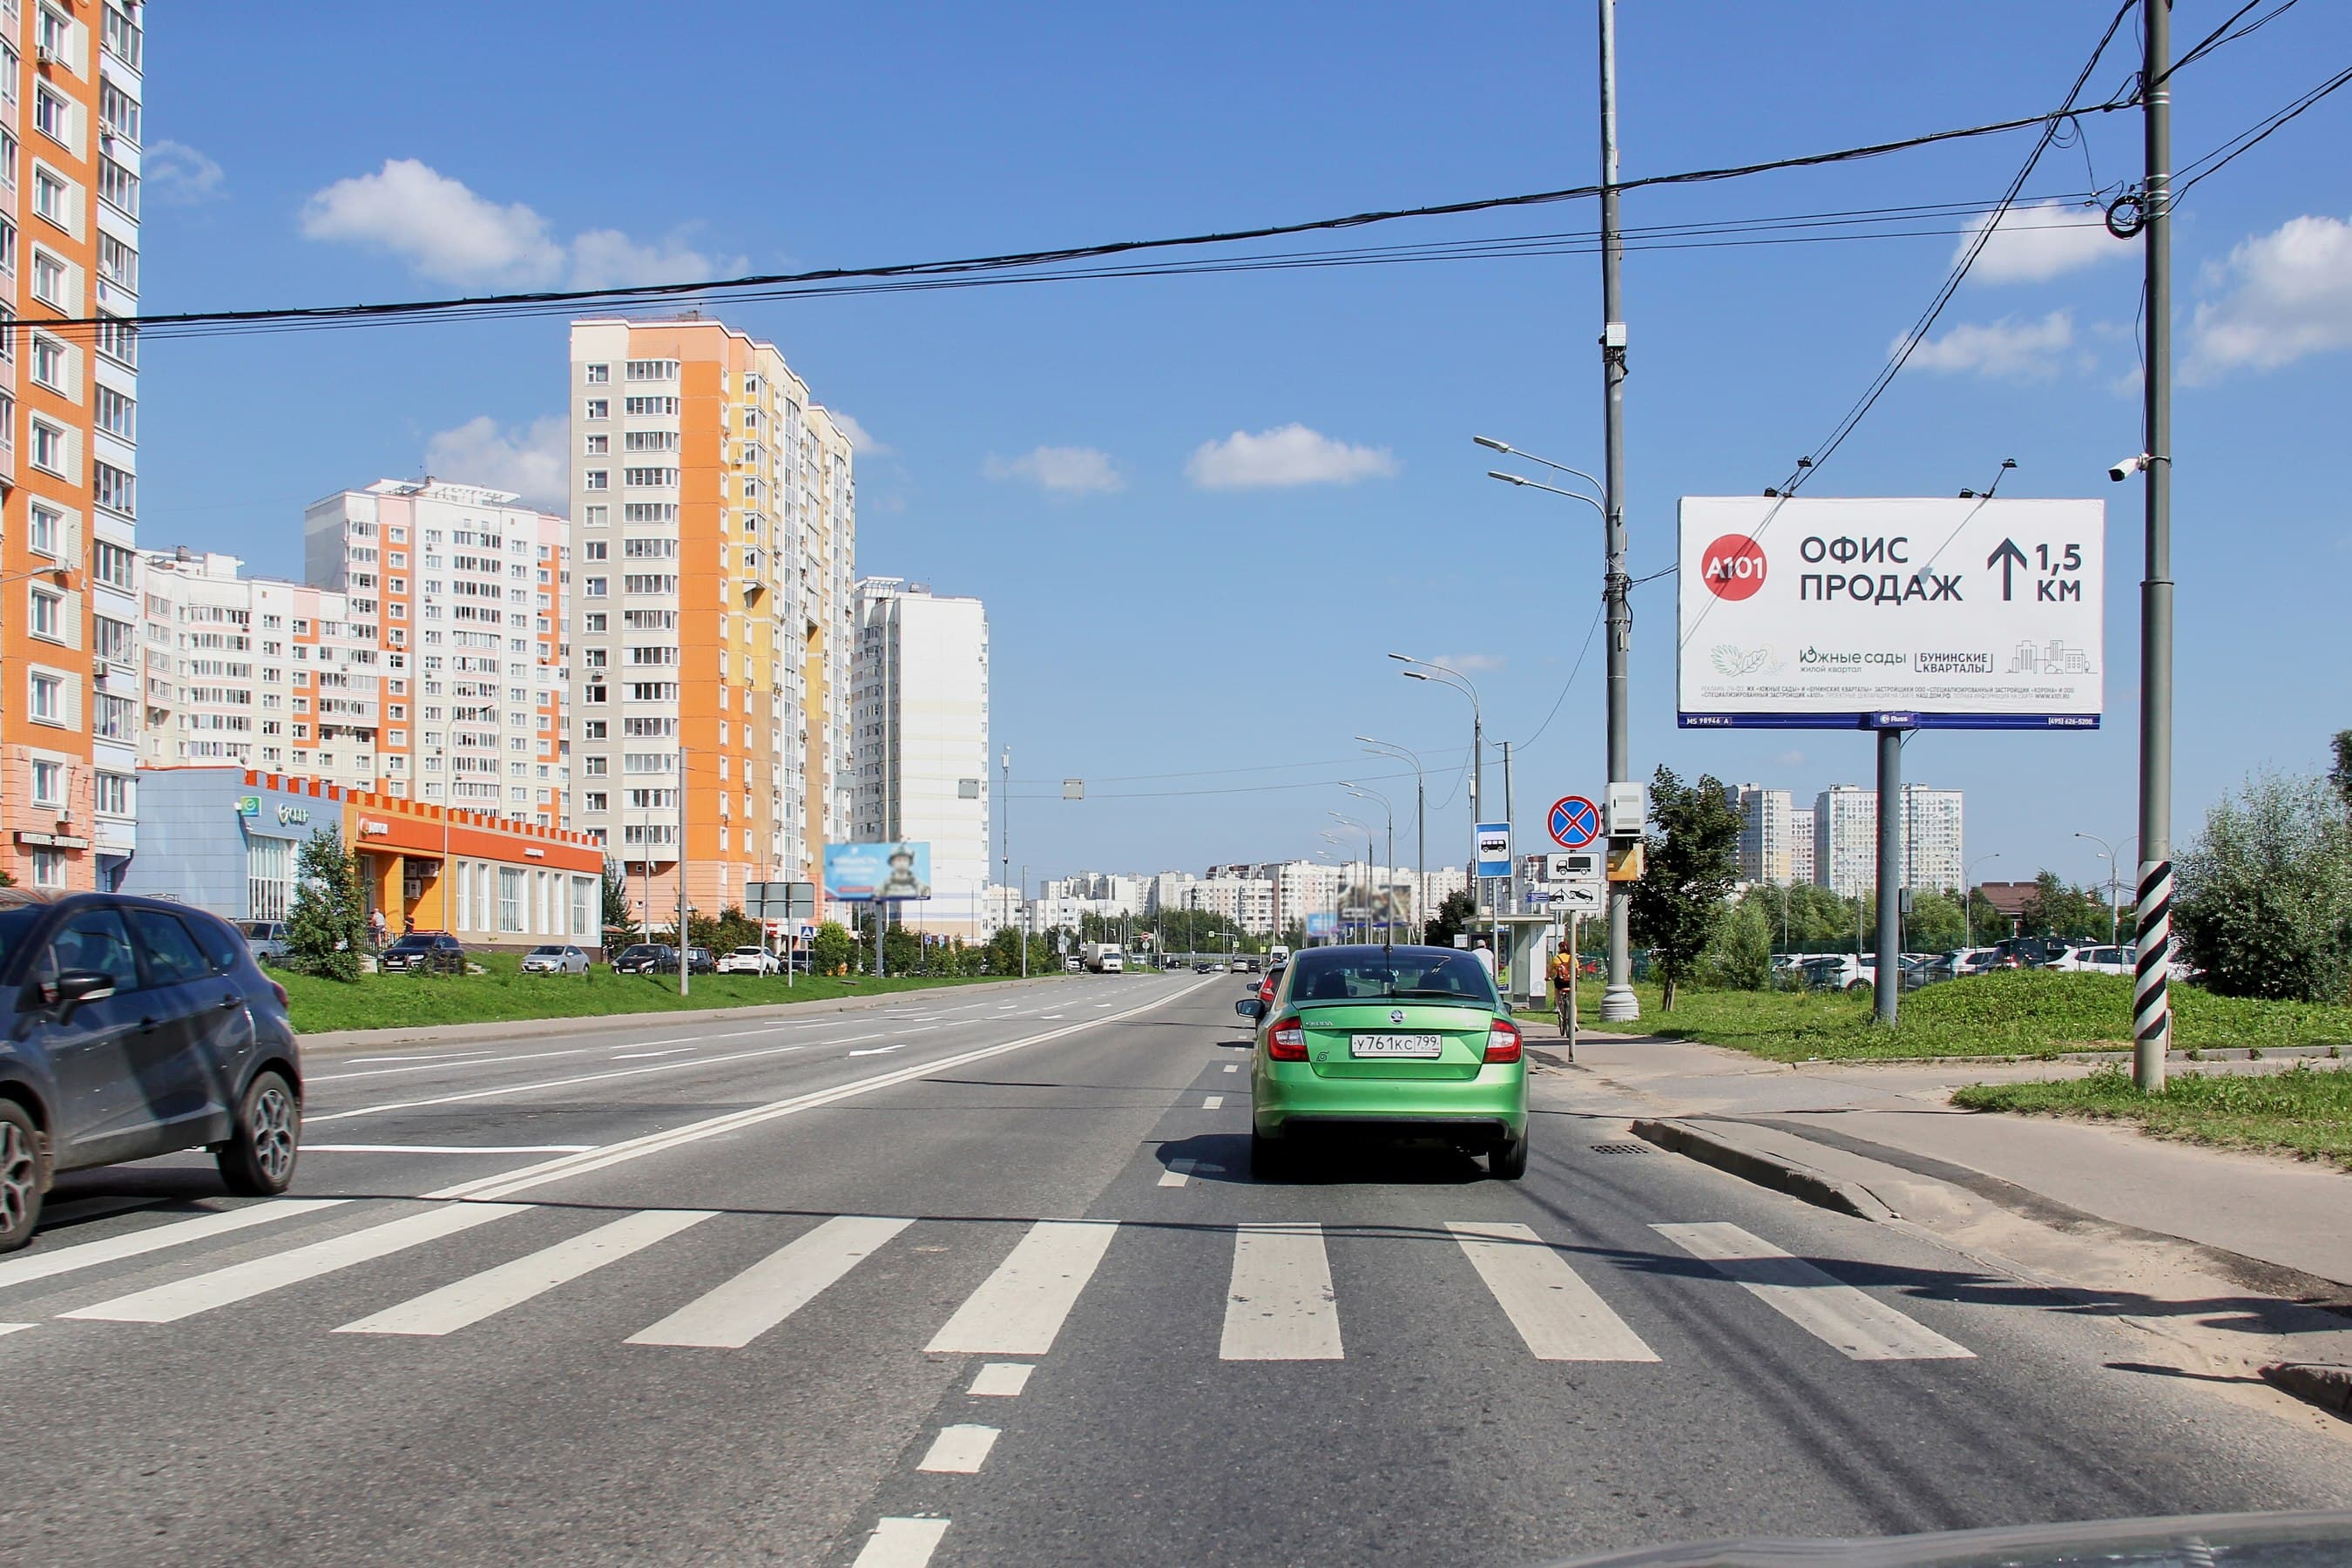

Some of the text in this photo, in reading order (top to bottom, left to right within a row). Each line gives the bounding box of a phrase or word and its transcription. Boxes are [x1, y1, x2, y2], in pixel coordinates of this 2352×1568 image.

[1799, 535, 1909, 564] ОФИС
[2035, 543, 2083, 576] 1,5
[1800, 573, 1964, 606] ПРОДАЖ
[2038, 579, 2082, 602] КМ
[1799, 646, 1907, 666] Южные сады
[1920, 652, 1988, 663] БУНИНСКИЕ
[1923, 663, 1985, 673] КВАРТАЛЫ
[1416, 1036, 1437, 1046] 799
